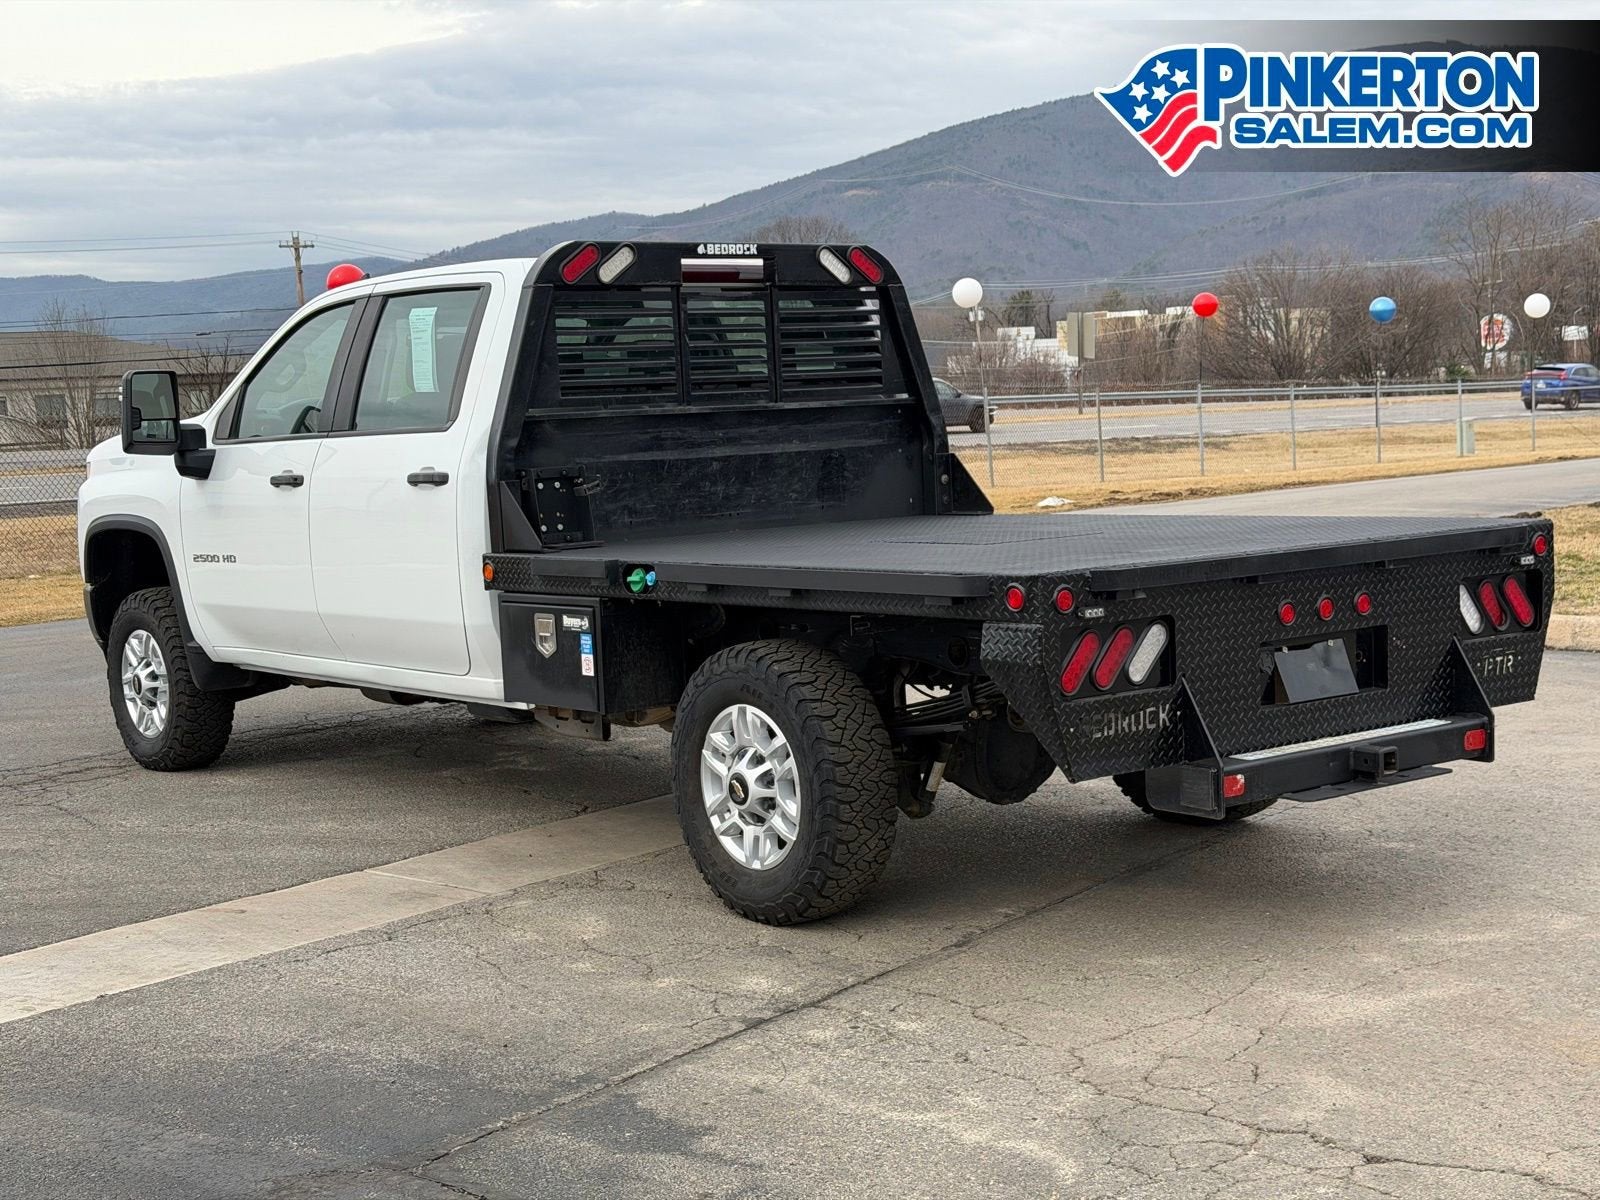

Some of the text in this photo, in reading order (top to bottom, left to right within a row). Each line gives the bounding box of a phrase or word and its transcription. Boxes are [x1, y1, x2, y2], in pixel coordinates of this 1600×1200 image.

[706, 243, 758, 255] BEDROCK
[192, 554, 237, 563] 2500 HD
